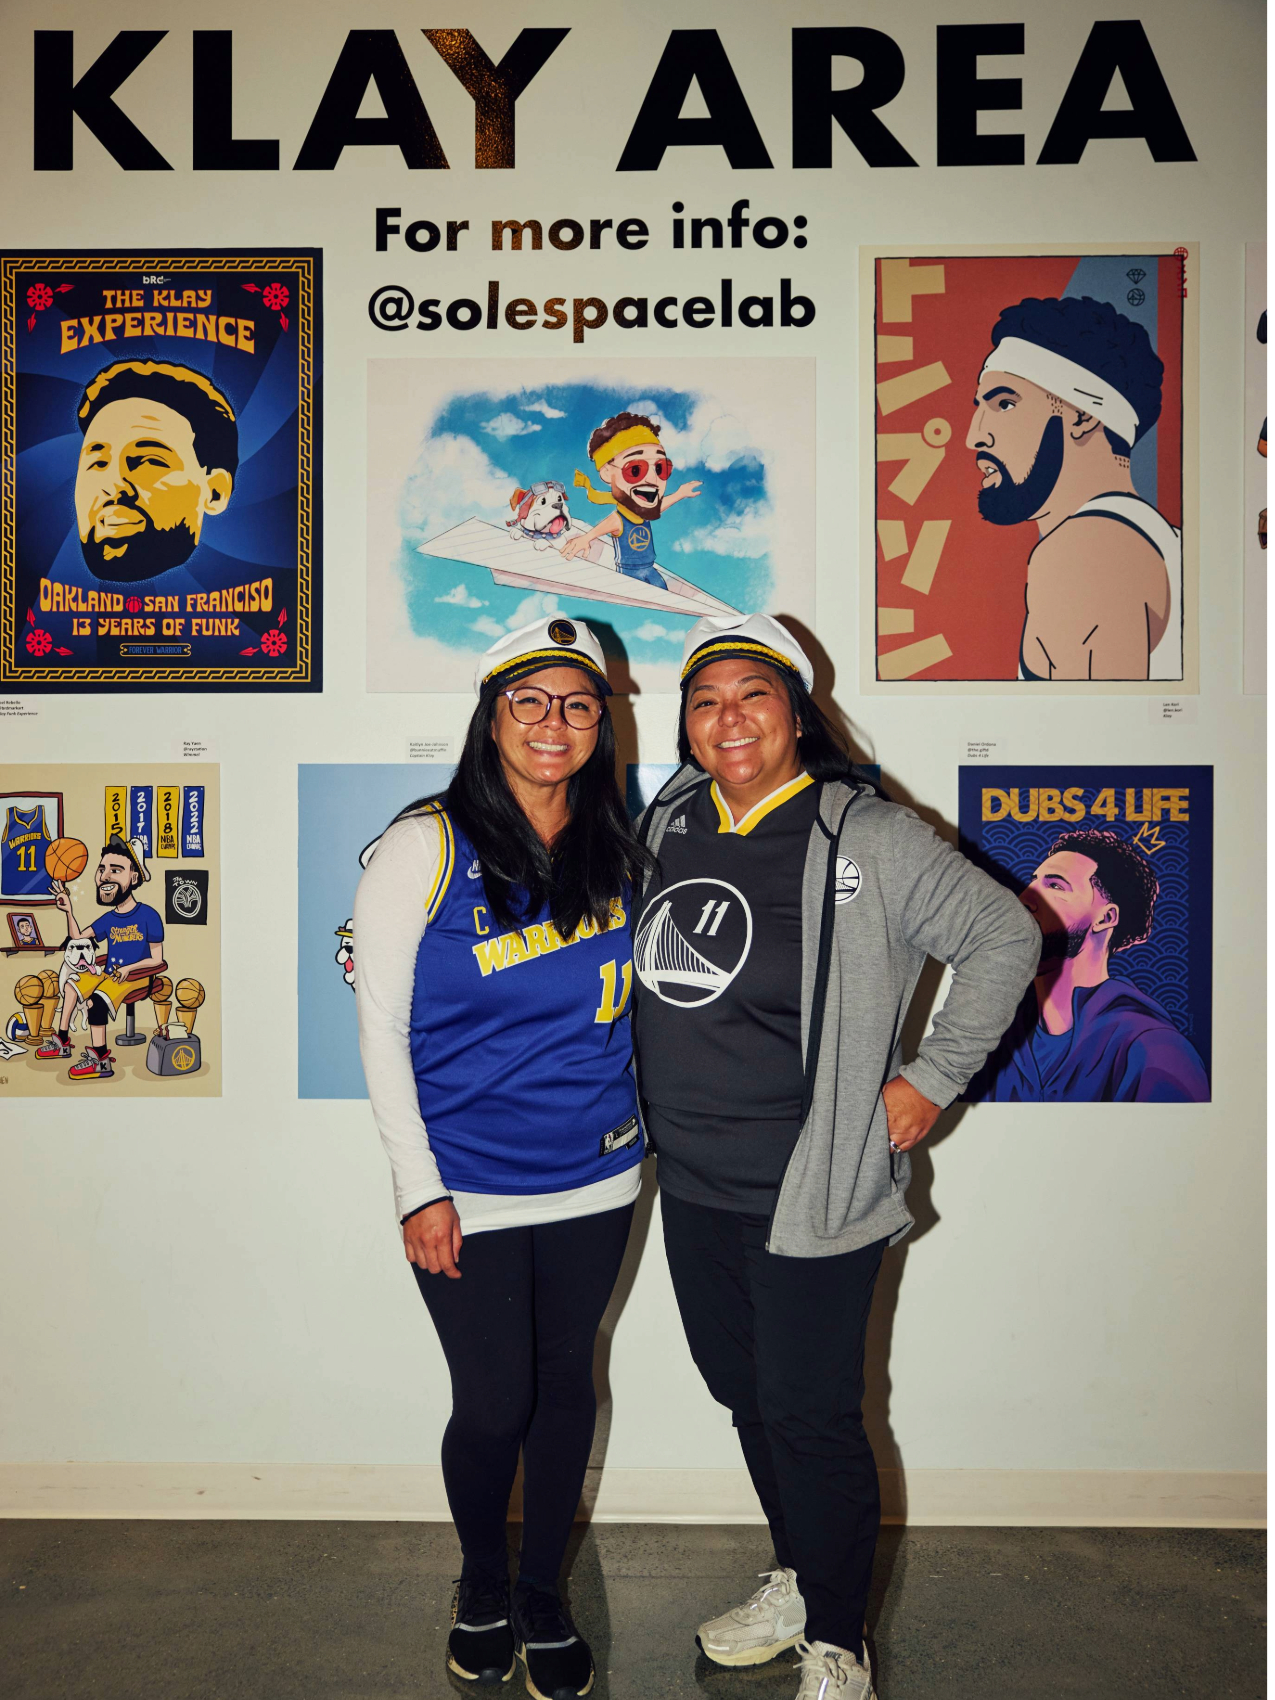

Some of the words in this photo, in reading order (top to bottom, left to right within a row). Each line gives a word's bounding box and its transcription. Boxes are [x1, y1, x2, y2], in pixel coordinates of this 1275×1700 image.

[34, 28, 572, 171] KLAY
[615, 19, 1199, 171] AREA
[375, 207, 470, 253] For
[491, 216, 650, 252] more
[672, 200, 808, 250] info:
[103, 290, 144, 308] THE
[153, 289, 212, 308] KLAY
[368, 278, 816, 344] @solespacelab
[60, 312, 255, 354] EXPERIENCE
[40, 577, 124, 612] OAKLAND
[144, 596, 179, 612] SAN
[186, 577, 273, 612] FRANCISO
[72, 618, 91, 636] 13
[97, 618, 155, 636] YEARS
[162, 618, 185, 636] OF
[191, 618, 240, 636] FUNK
[137, 791, 147, 833] 2017
[163, 791, 173, 834] 2018
[189, 790, 199, 834] 2022
[981, 787, 1086, 822] DUBS
[1090, 788, 1119, 821] 4
[1126, 788, 1190, 822] LIFE
[161, 834, 175, 844] NBA
[186, 834, 201, 844] NBA
[16, 845, 37, 871] 11
[473, 906, 489, 935] C
[692, 899, 731, 936] 11
